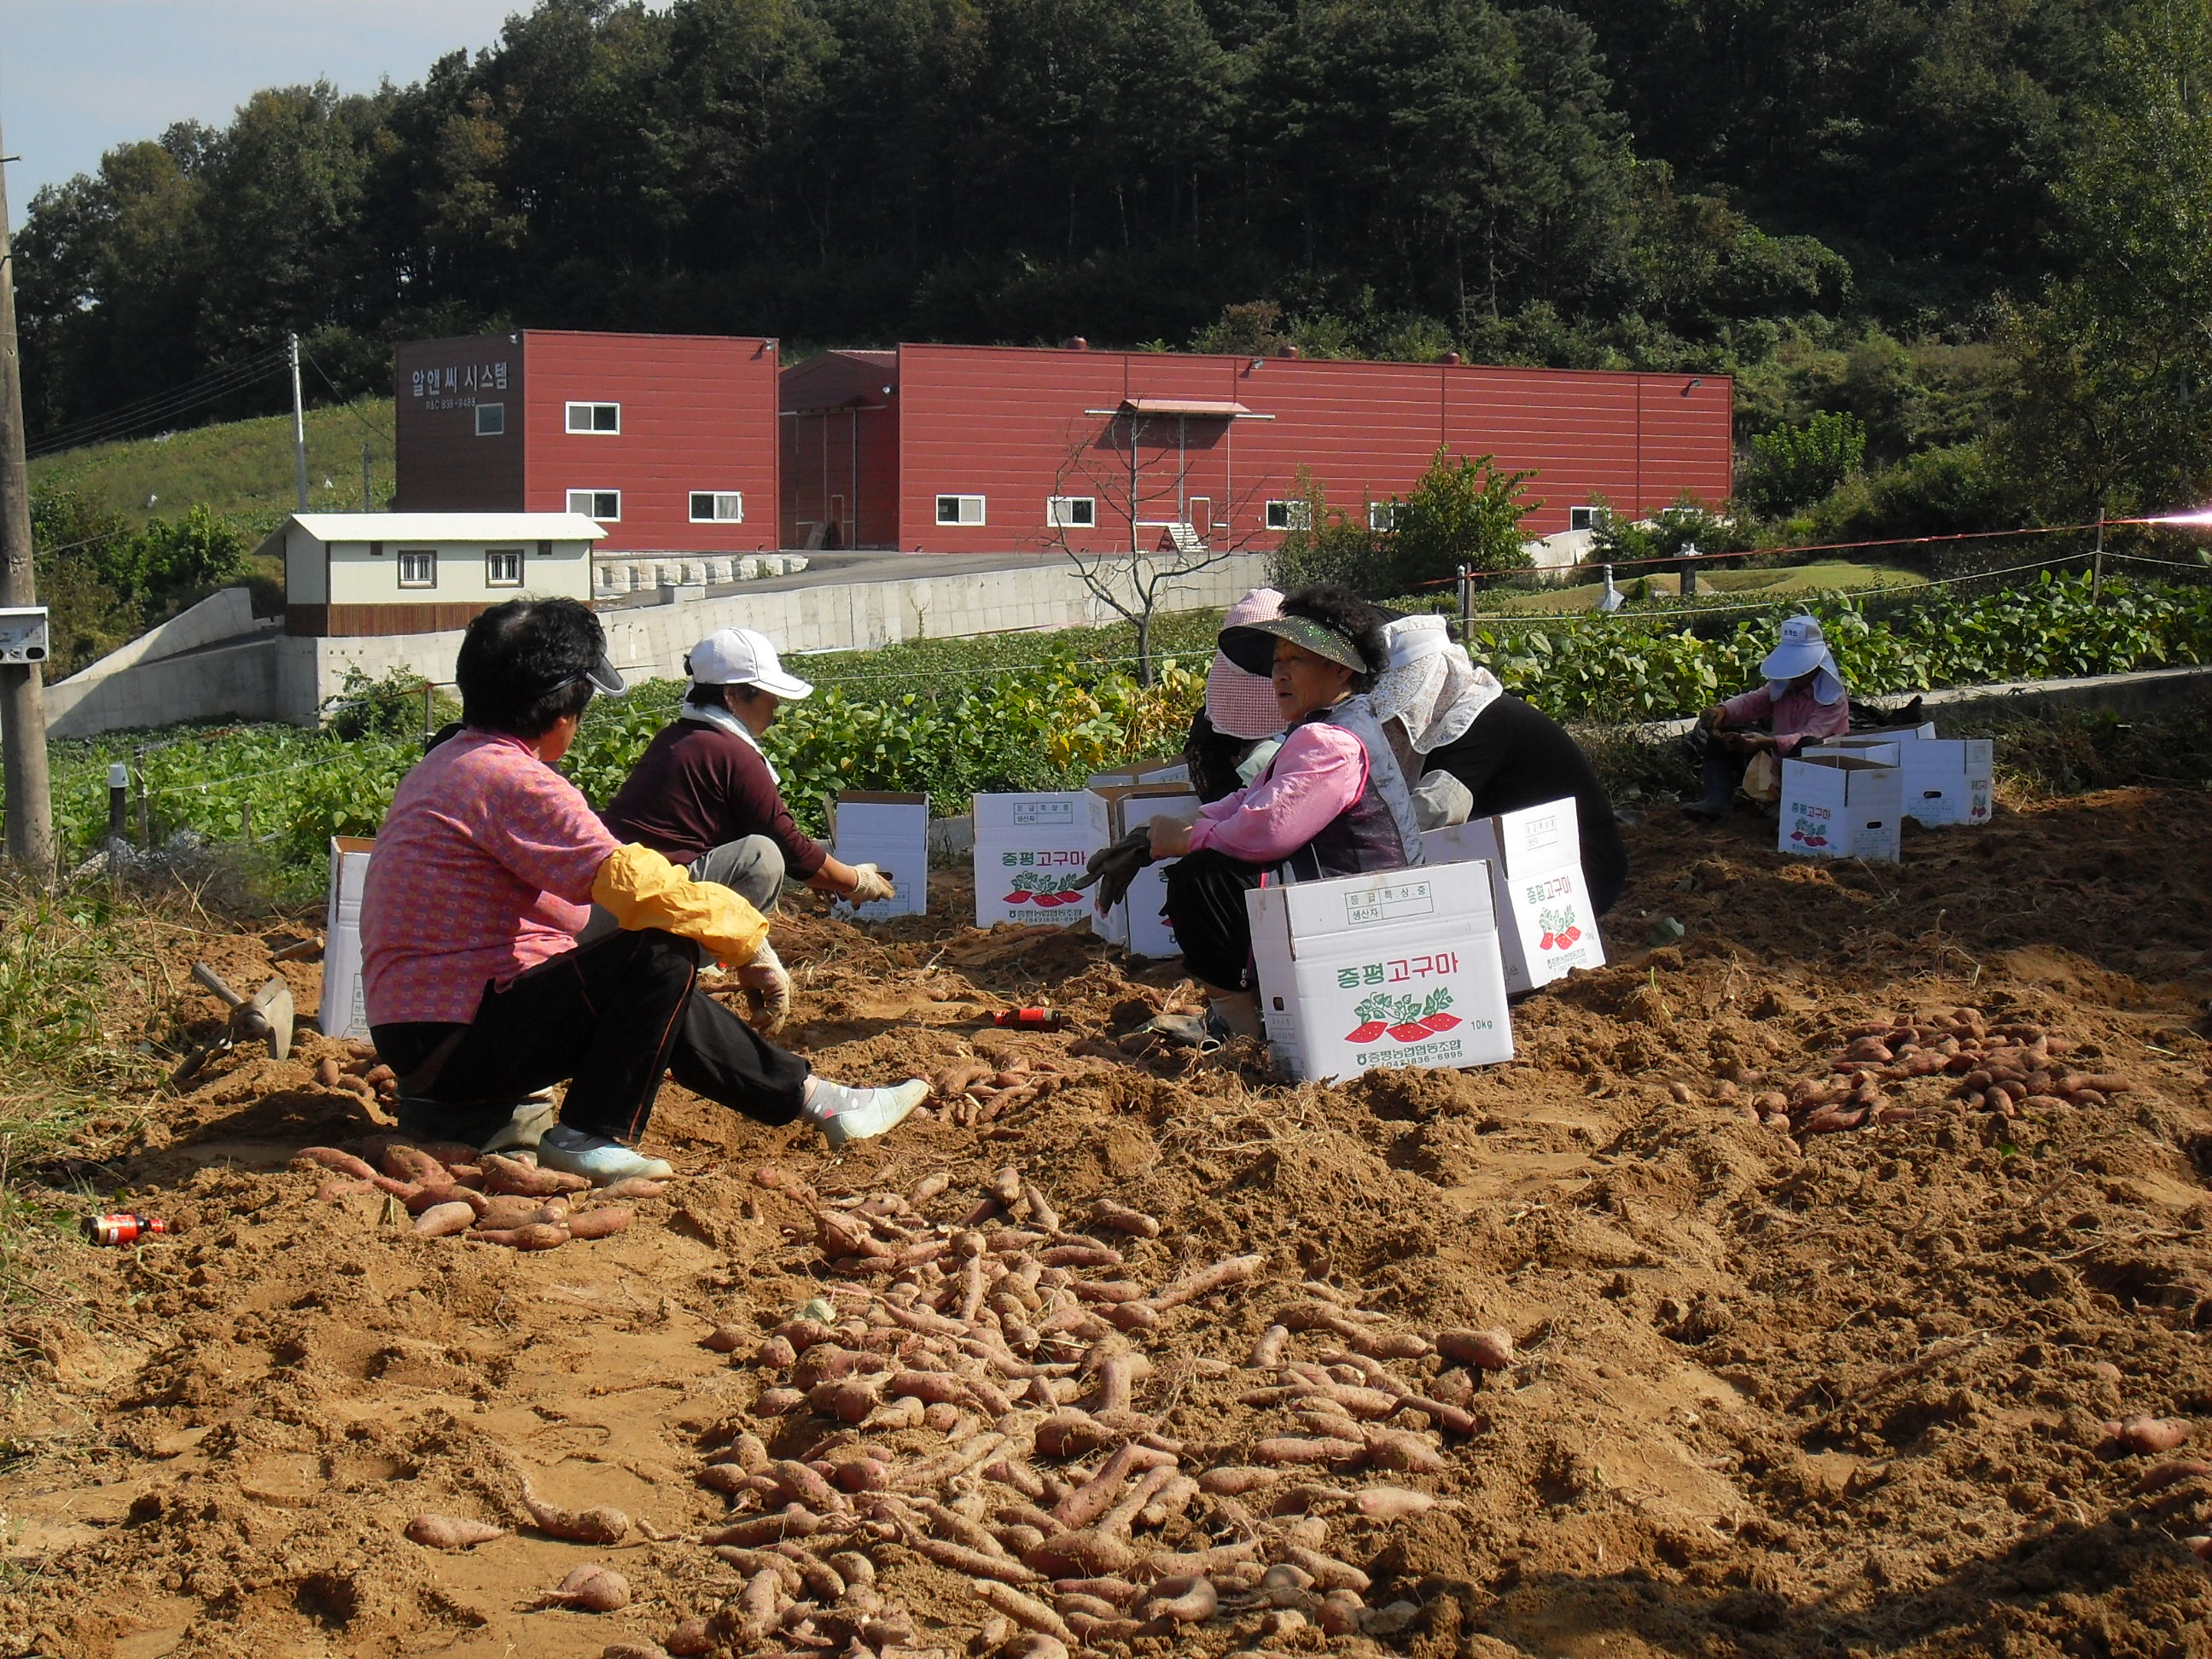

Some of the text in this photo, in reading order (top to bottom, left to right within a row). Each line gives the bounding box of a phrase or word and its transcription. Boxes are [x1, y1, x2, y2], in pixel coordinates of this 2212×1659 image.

[464, 362, 508, 391] 시스템
[1002, 851, 1086, 866] 증평고구마
[1352, 907, 1378, 921] 생산자
[1337, 952, 1458, 989] 증평고구마
[1470, 1020, 1493, 1031] 10kg
[1368, 1039, 1462, 1063] 증평농업협동조합
